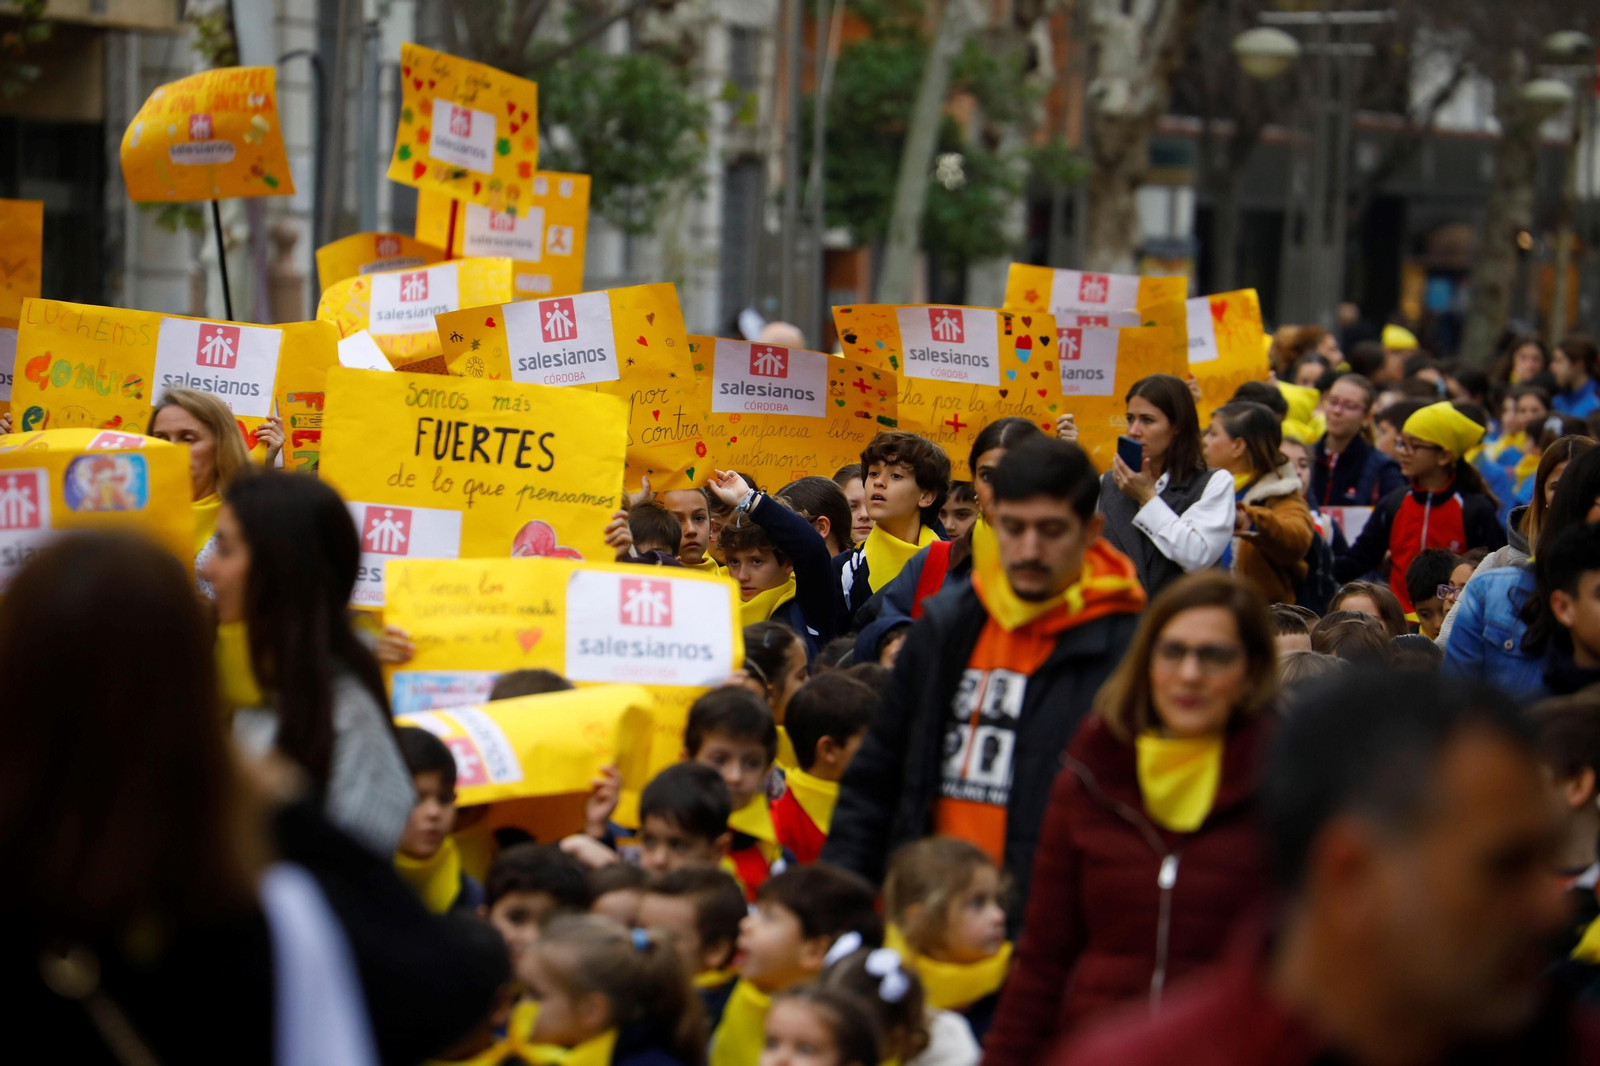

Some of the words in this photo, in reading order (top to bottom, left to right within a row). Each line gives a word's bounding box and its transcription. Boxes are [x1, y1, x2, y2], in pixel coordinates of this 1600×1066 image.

[376, 303, 449, 320] salesianos
[517, 347, 607, 372] salesianos
[909, 346, 990, 368] salesianos
[161, 372, 260, 397] salesianos
[543, 371, 586, 385] CÓRDOBA
[930, 367, 969, 380] CÓRDOBA
[1061, 365, 1105, 380] ianos
[719, 380, 815, 402] salesianos
[969, 384, 988, 413] la
[629, 387, 670, 425] por
[743, 401, 790, 412] CÓRDOBA
[640, 404, 702, 445] contra
[414, 416, 555, 472] FUERTES
[387, 462, 417, 488] de
[430, 465, 454, 493] lo
[462, 477, 506, 510] que
[516, 483, 615, 512] pensamos
[577, 635, 714, 661] salesianos
